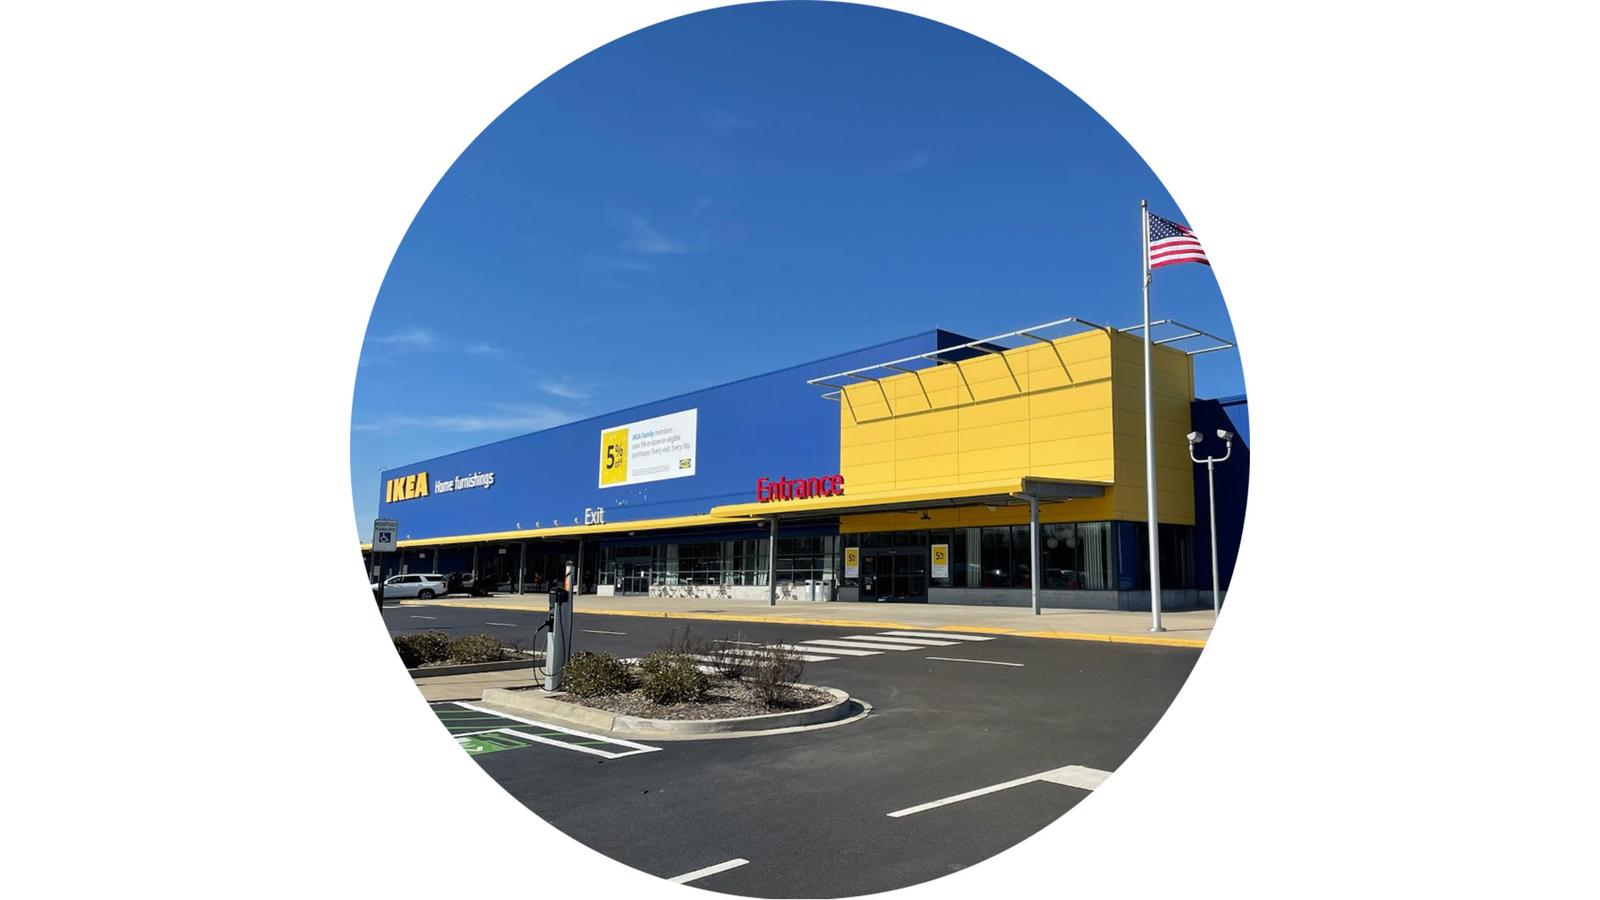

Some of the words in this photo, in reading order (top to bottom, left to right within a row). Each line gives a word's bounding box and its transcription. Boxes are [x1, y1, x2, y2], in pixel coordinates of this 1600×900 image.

[386, 472, 429, 503] IKEA
[434, 480, 454, 493] Home
[454, 472, 494, 489] furnishings
[756, 474, 844, 503] Entrance
[584, 507, 606, 525] Exit
